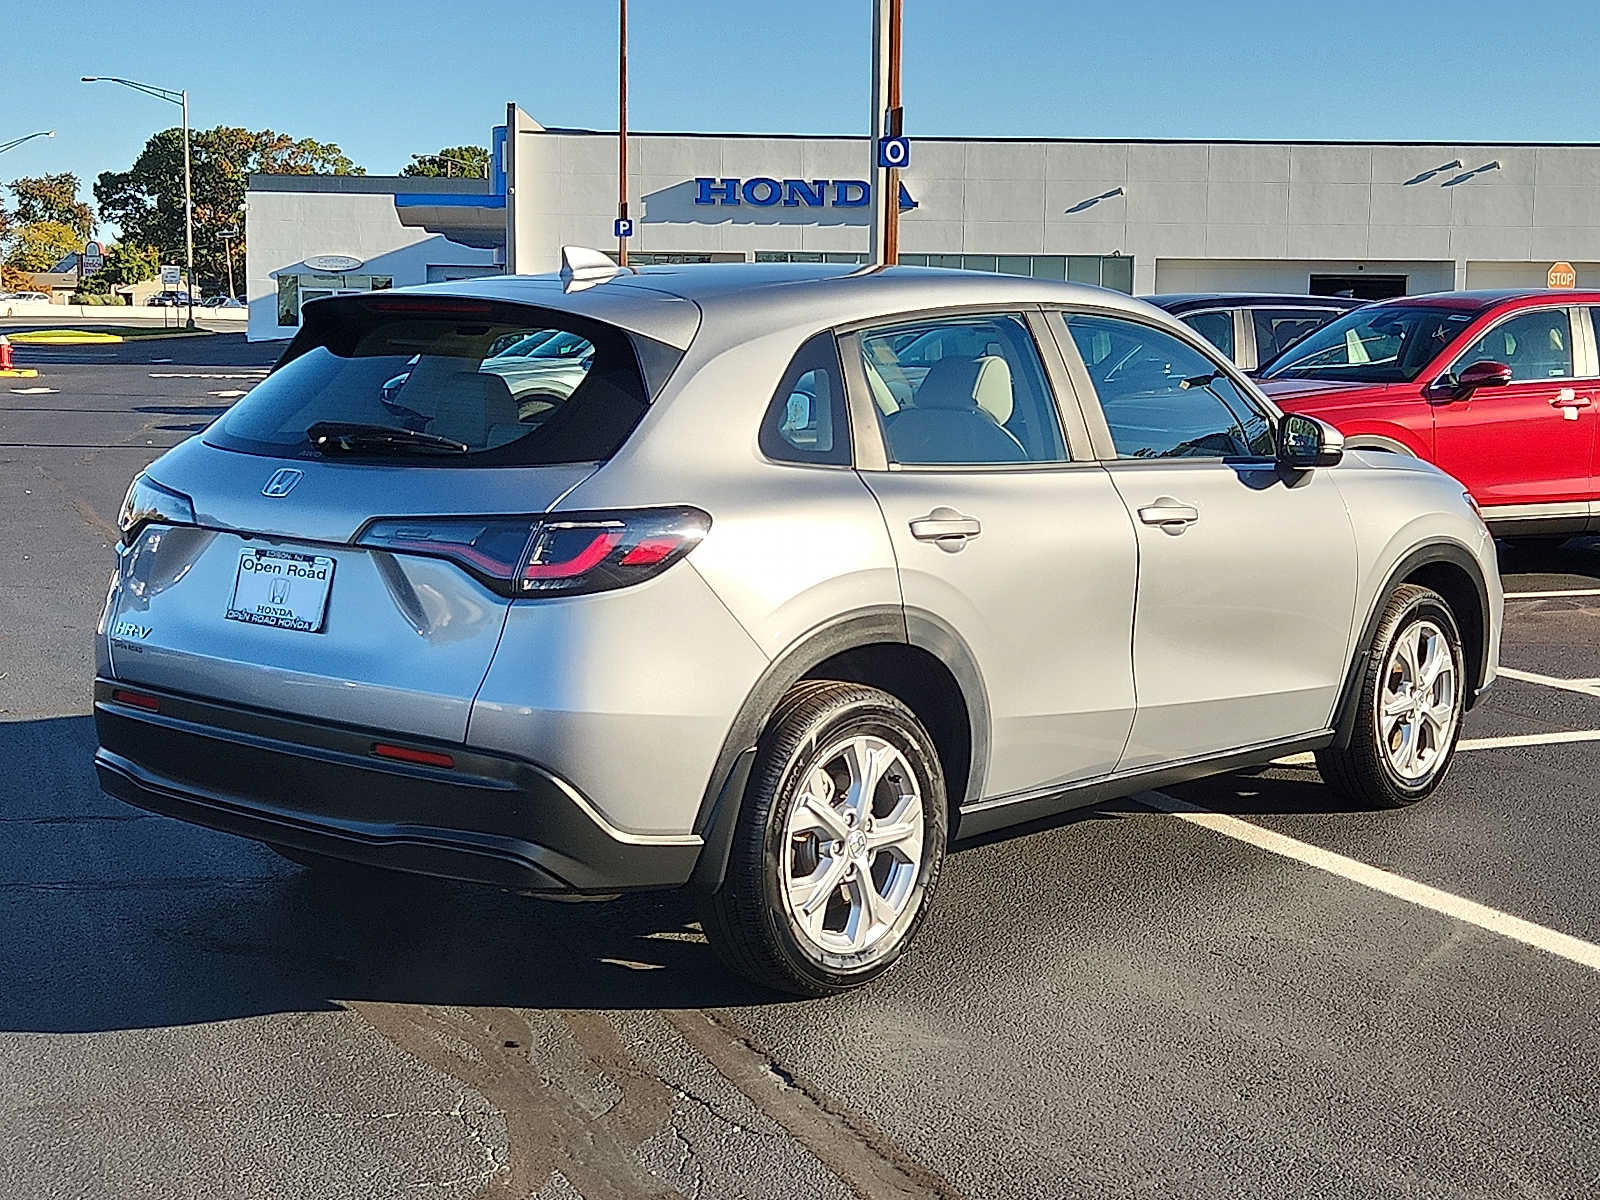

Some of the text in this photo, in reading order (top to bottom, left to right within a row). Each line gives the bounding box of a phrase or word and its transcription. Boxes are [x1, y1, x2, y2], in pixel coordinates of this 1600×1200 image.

[619, 220, 630, 235] P
[1549, 272, 1574, 286] STOP
[242, 558, 327, 581] Open Road
[256, 604, 294, 618] HONDA
[227, 609, 310, 630] OPEN ROAD HONDA
